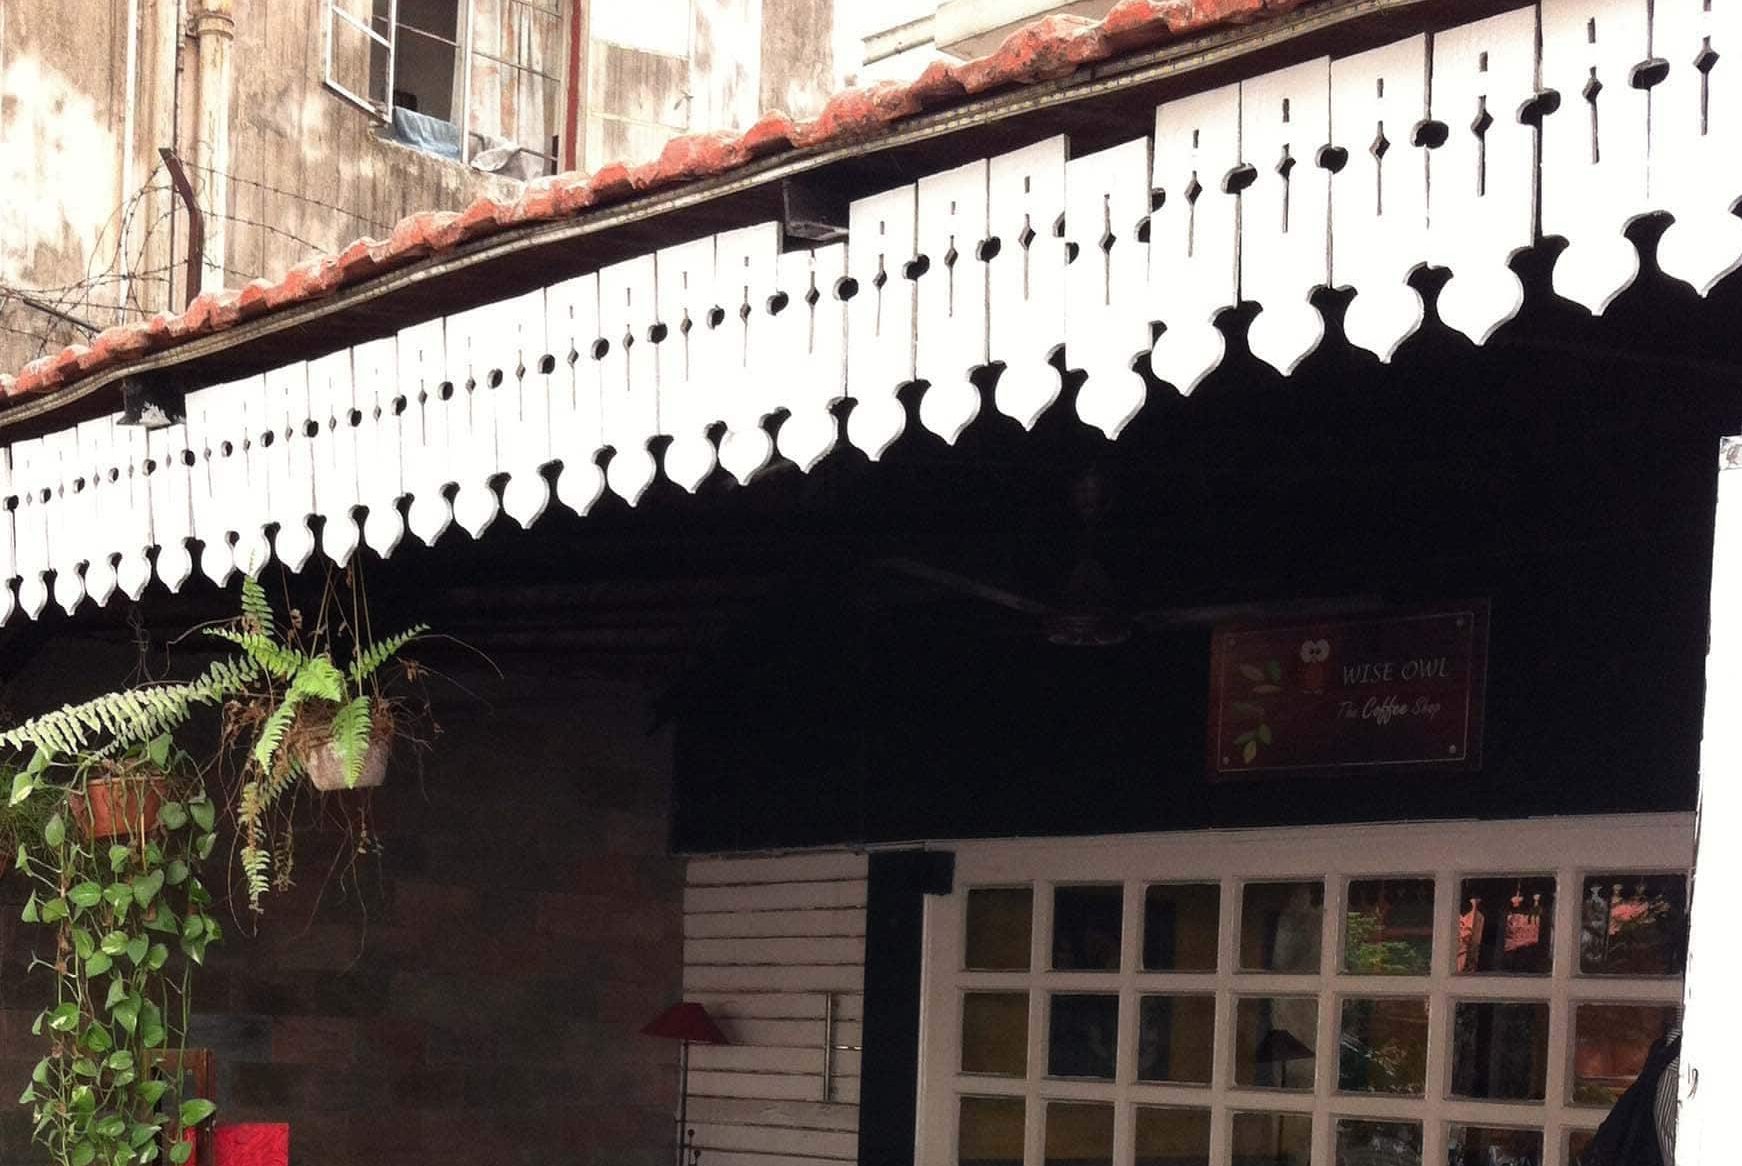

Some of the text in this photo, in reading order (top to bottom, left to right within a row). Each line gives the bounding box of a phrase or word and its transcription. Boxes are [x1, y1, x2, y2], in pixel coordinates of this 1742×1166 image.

[1343, 657, 1450, 687] WISE OWL
[1362, 696, 1408, 726] Coffee
